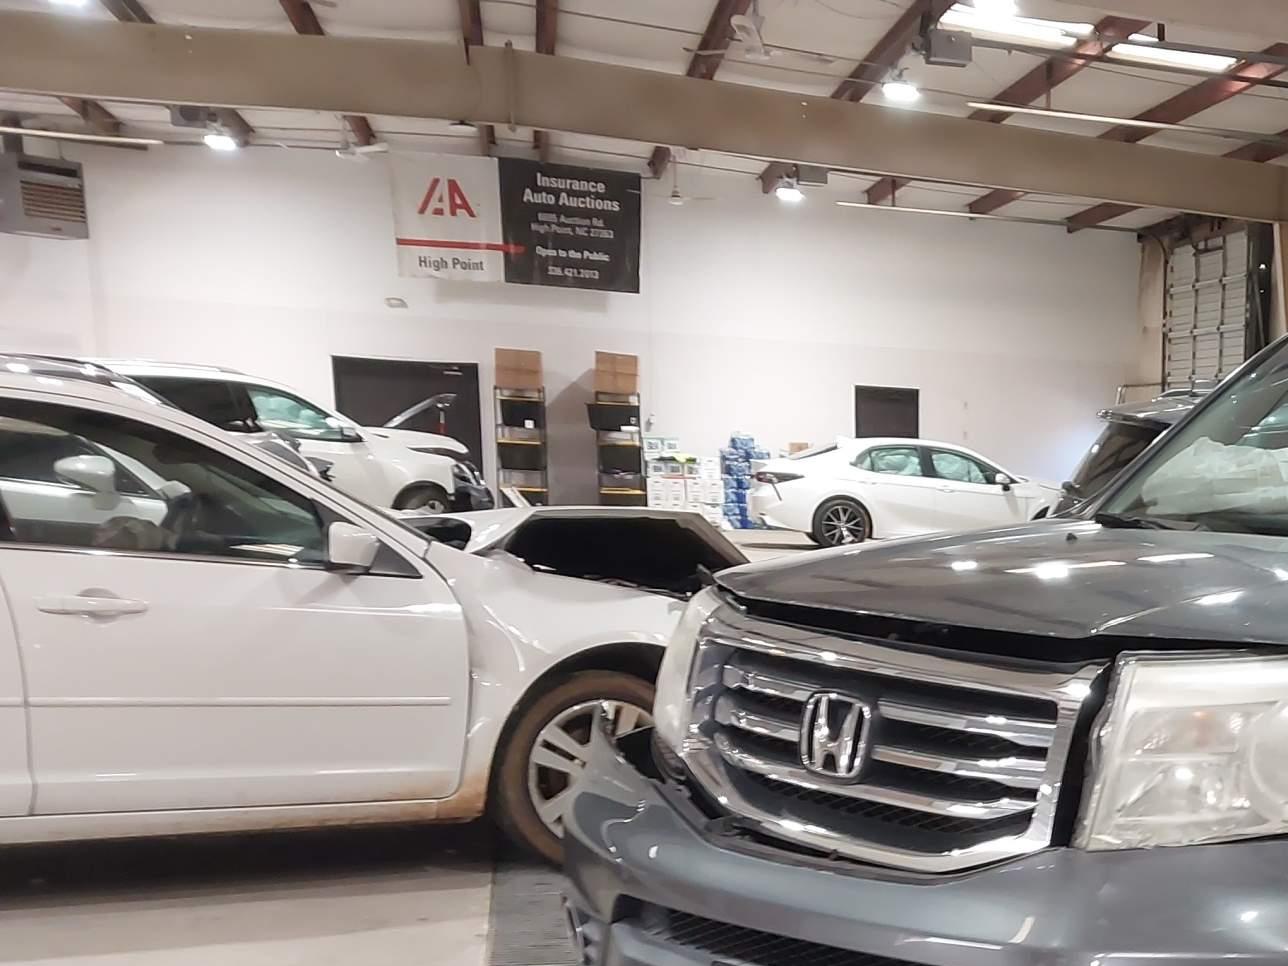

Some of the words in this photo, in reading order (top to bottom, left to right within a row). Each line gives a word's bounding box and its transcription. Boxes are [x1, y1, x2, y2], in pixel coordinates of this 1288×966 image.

[536, 172, 606, 193] Insurance
[523, 188, 556, 206] Auto
[559, 192, 621, 212] Auctions
[535, 245, 558, 257] Open
[558, 249, 567, 258] to
[568, 249, 582, 259] the
[583, 250, 610, 261] Public
[418, 256, 449, 270] High
[452, 257, 484, 272] Point
